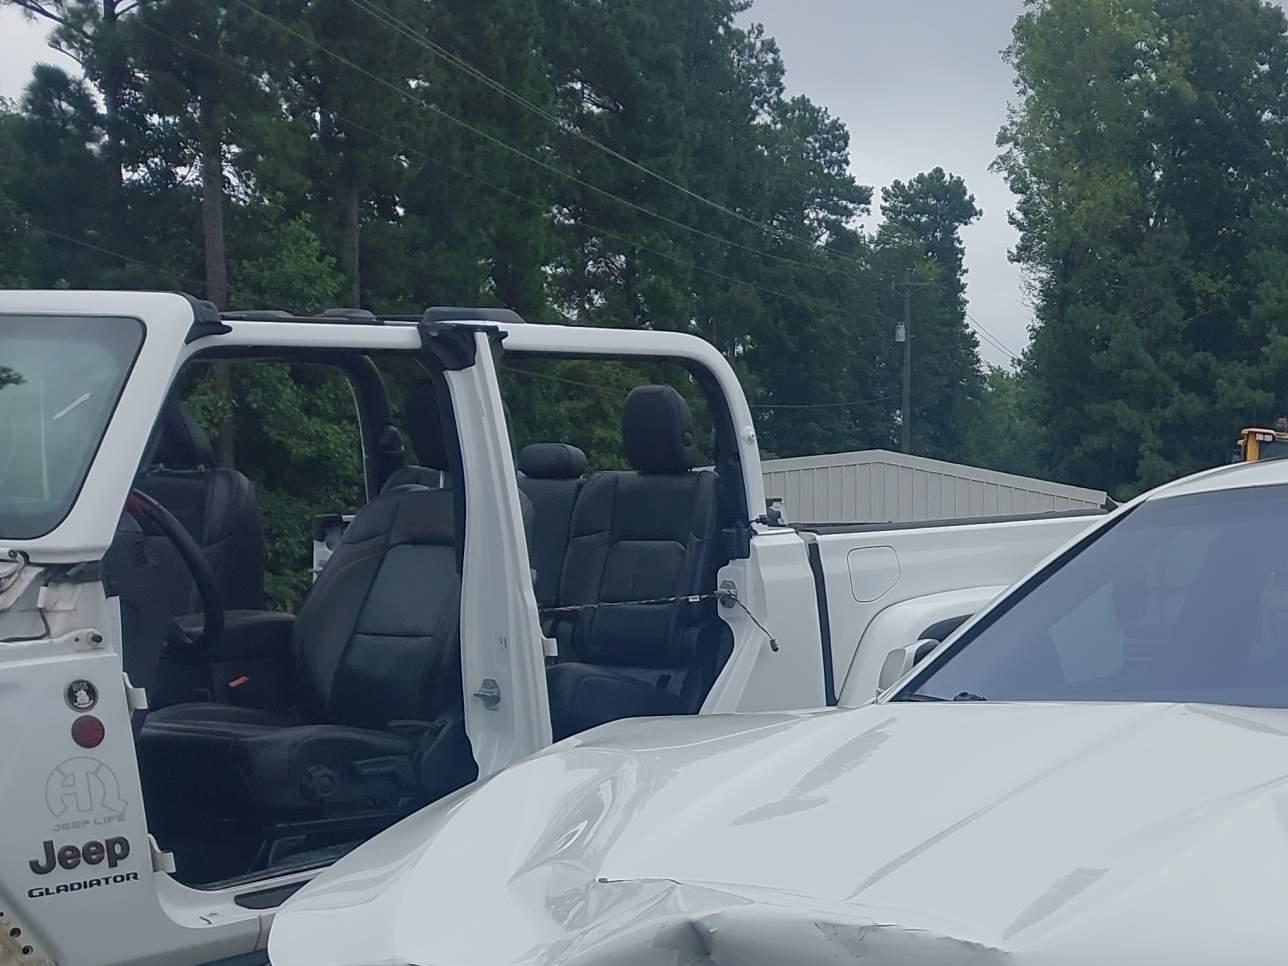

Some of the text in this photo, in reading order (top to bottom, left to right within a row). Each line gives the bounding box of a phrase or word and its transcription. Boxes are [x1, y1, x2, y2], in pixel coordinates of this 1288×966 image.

[52, 819, 91, 832] JEEP
[28, 835, 131, 876] Jeep
[27, 871, 140, 899] GLADIATOR
